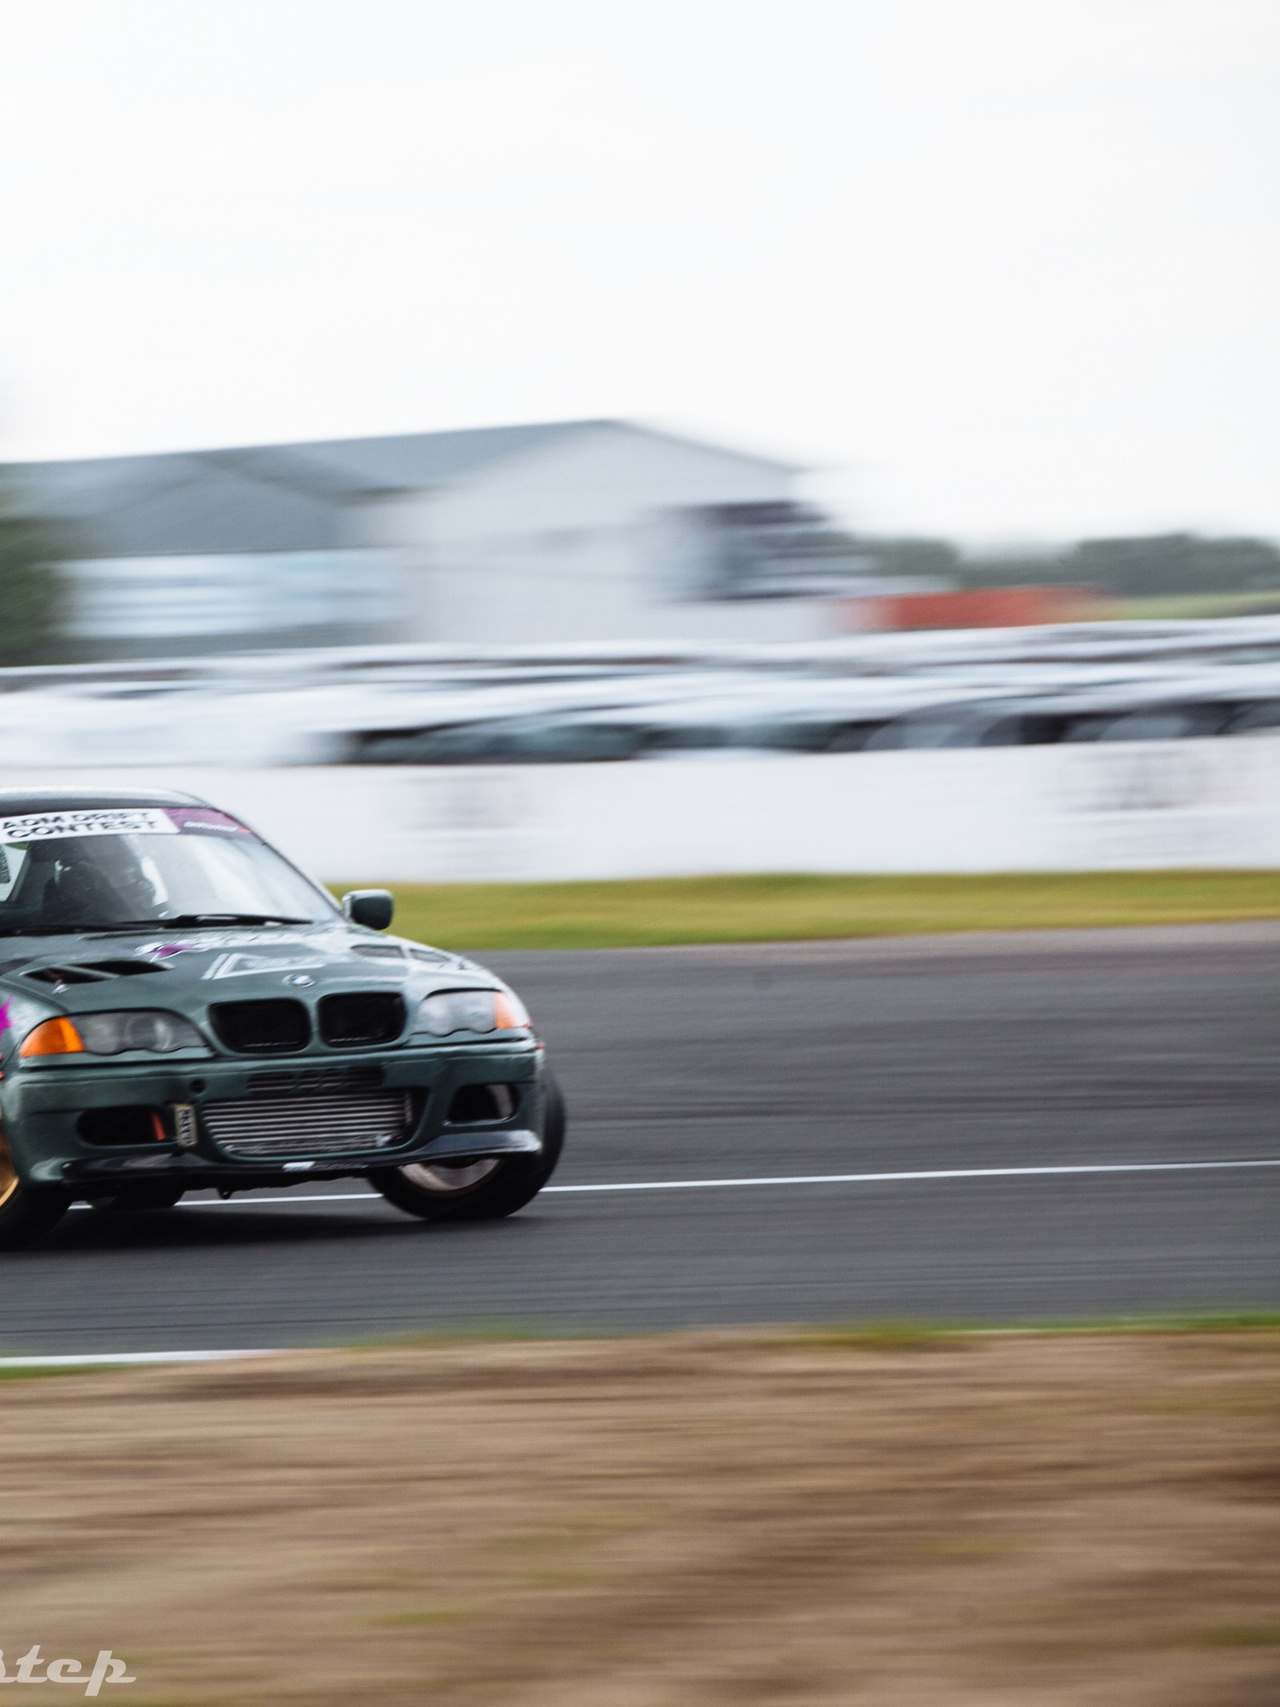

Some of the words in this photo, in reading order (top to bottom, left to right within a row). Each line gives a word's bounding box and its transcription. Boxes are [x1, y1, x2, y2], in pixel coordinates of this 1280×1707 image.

[3, 815, 65, 829] ADM
[72, 812, 150, 822] DRIFT
[7, 821, 157, 838] CONTEST
